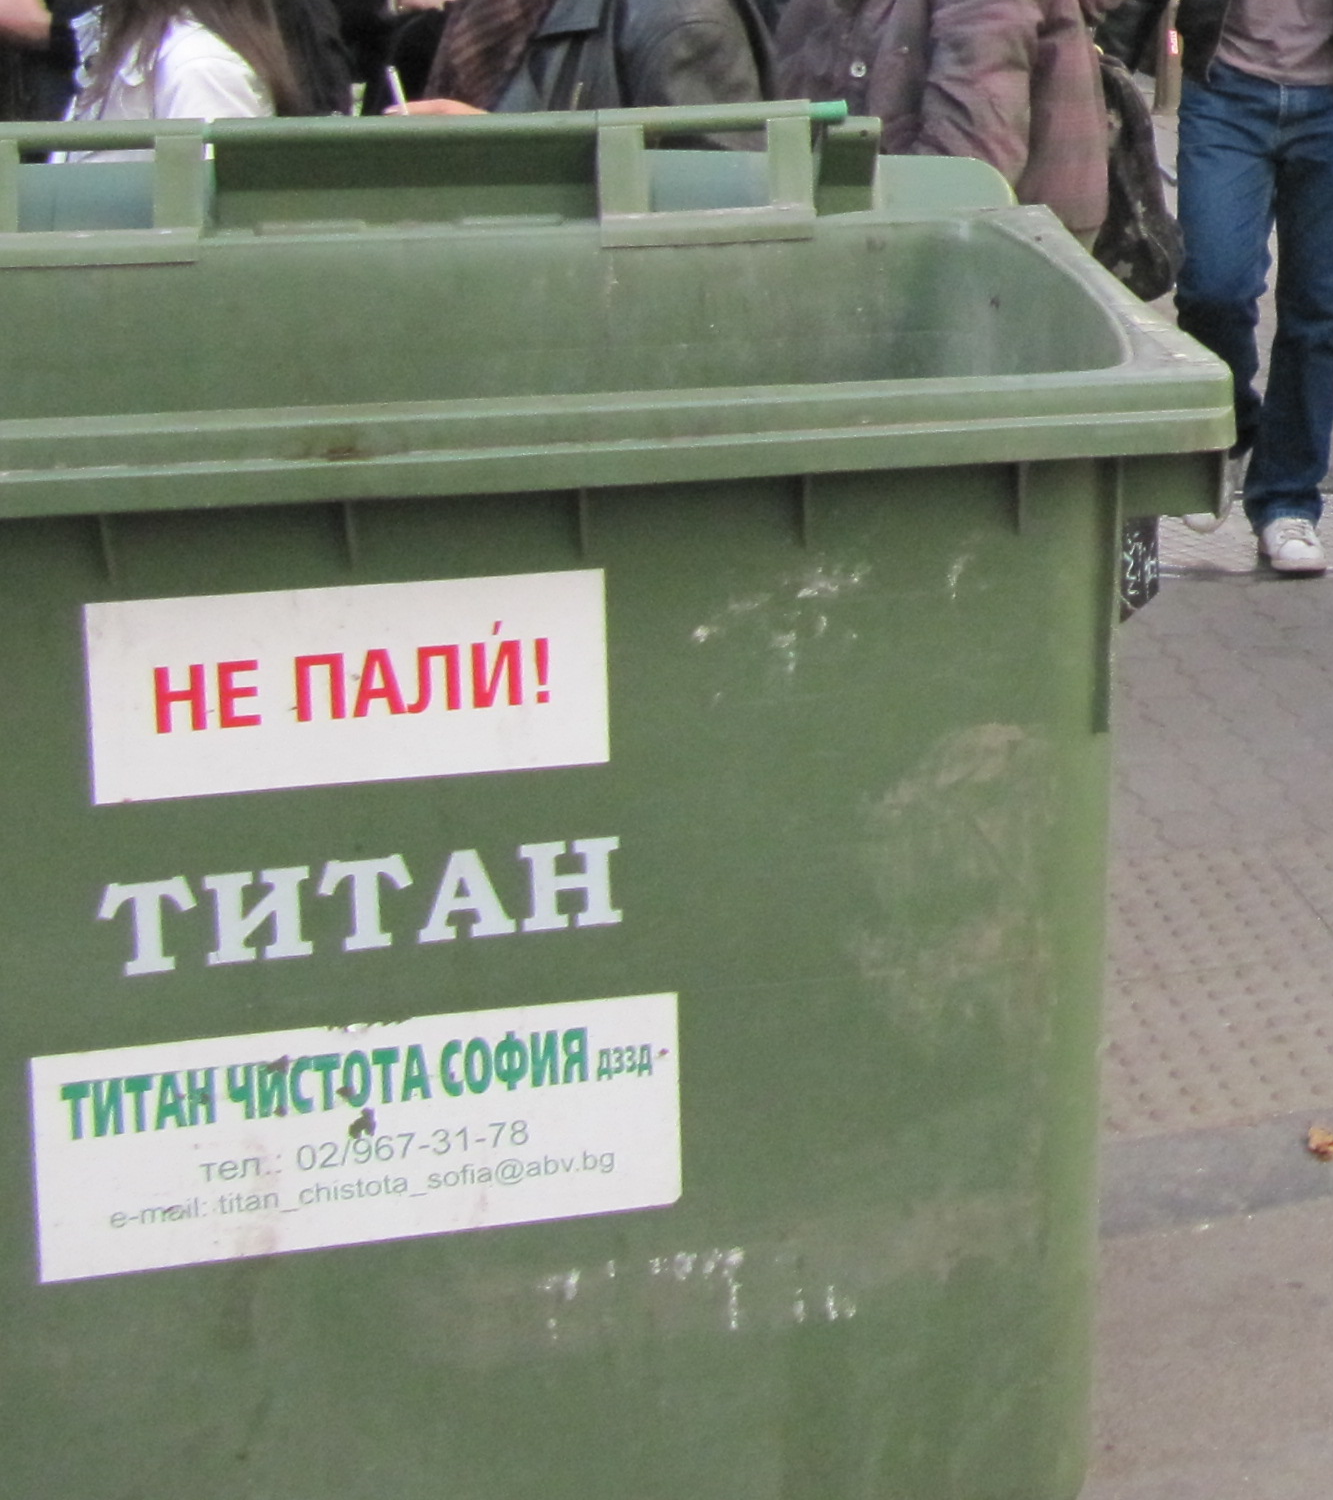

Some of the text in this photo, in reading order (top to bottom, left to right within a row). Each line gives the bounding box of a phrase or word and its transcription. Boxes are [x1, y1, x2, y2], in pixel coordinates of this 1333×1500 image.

[153, 659, 262, 734] НЕ
[97, 835, 623, 978] ТИТАН
[60, 1065, 218, 1141] ТИТАН
[226, 1042, 431, 1120] ЧИСТОТА
[439, 1026, 589, 1097] СОФИЯ
[296, 1118, 530, 1172] 02/967-31-78
[109, 1149, 616, 1230] e-mail: titan_chistota_sofia@abv.bg
